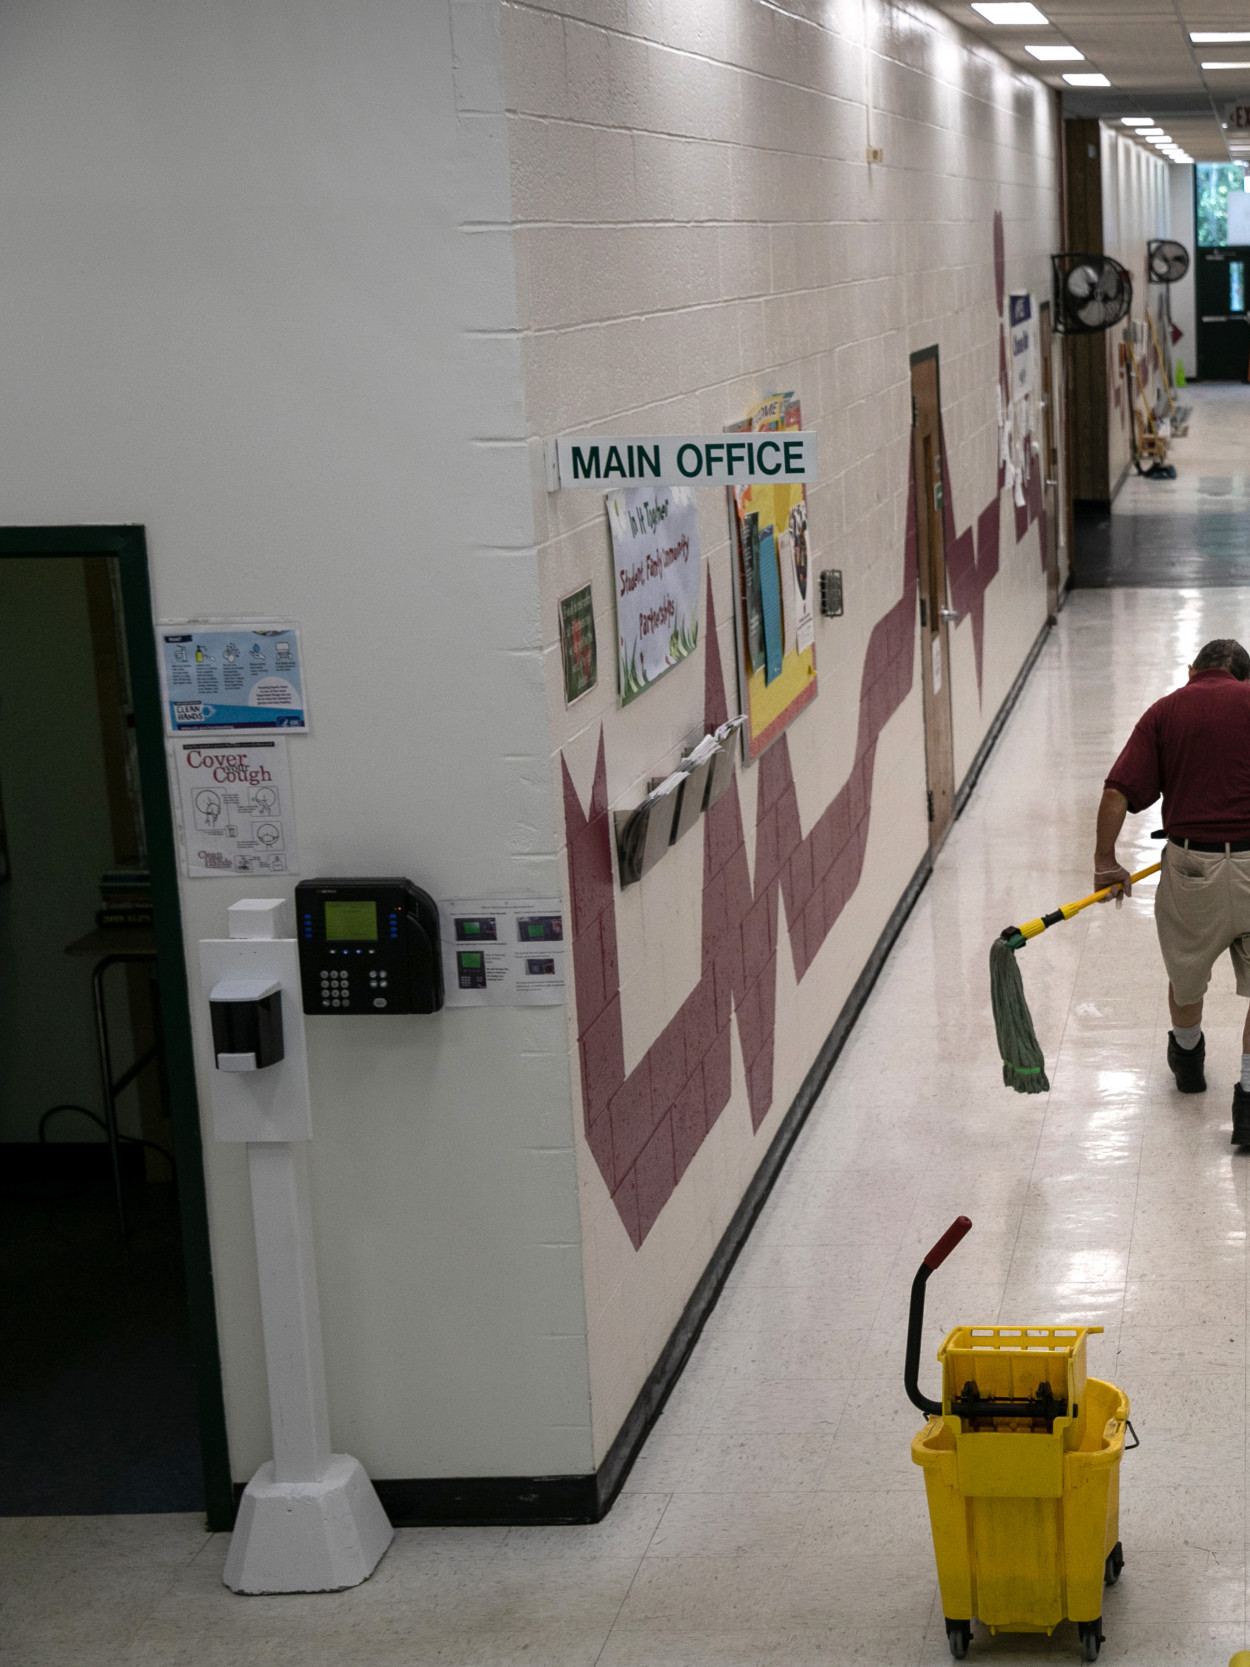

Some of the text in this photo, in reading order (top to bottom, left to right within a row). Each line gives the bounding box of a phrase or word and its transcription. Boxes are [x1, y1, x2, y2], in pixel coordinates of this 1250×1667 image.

[571, 440, 806, 480] MAIN OFFICE
[176, 705, 200, 714] CLEAN
[177, 712, 204, 722] HANDS
[186, 750, 248, 769] Cover
[213, 765, 273, 786] Cough
